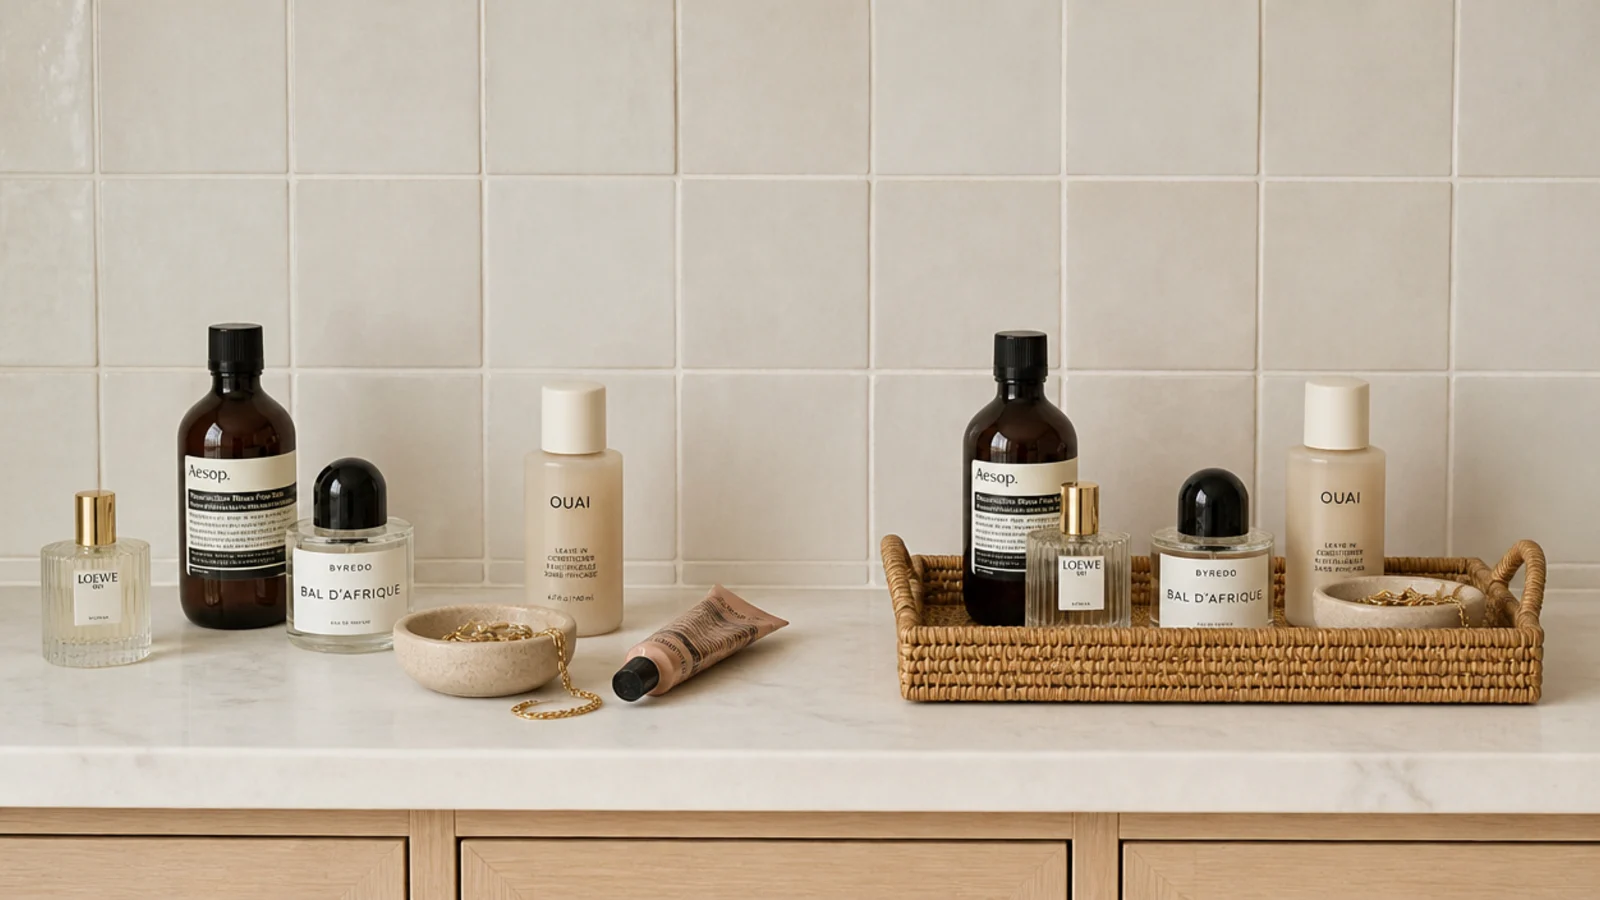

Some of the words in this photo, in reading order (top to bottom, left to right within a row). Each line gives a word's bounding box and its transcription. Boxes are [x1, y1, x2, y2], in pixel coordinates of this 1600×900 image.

[188, 464, 231, 484] Aesop.
[975, 467, 1019, 488] Aesop.
[550, 496, 590, 509] OUAI
[1320, 491, 1361, 505] OUAI
[329, 563, 373, 572] BYREDO
[1062, 560, 1101, 570] LOEWE
[78, 572, 118, 584] LOEWE
[1195, 569, 1237, 577] BYREDO
[300, 585, 324, 599] BAL
[329, 583, 400, 600] D'AFRIQUE
[1167, 588, 1190, 602] BAL
[1194, 589, 1263, 604] D'AFRIQUE
